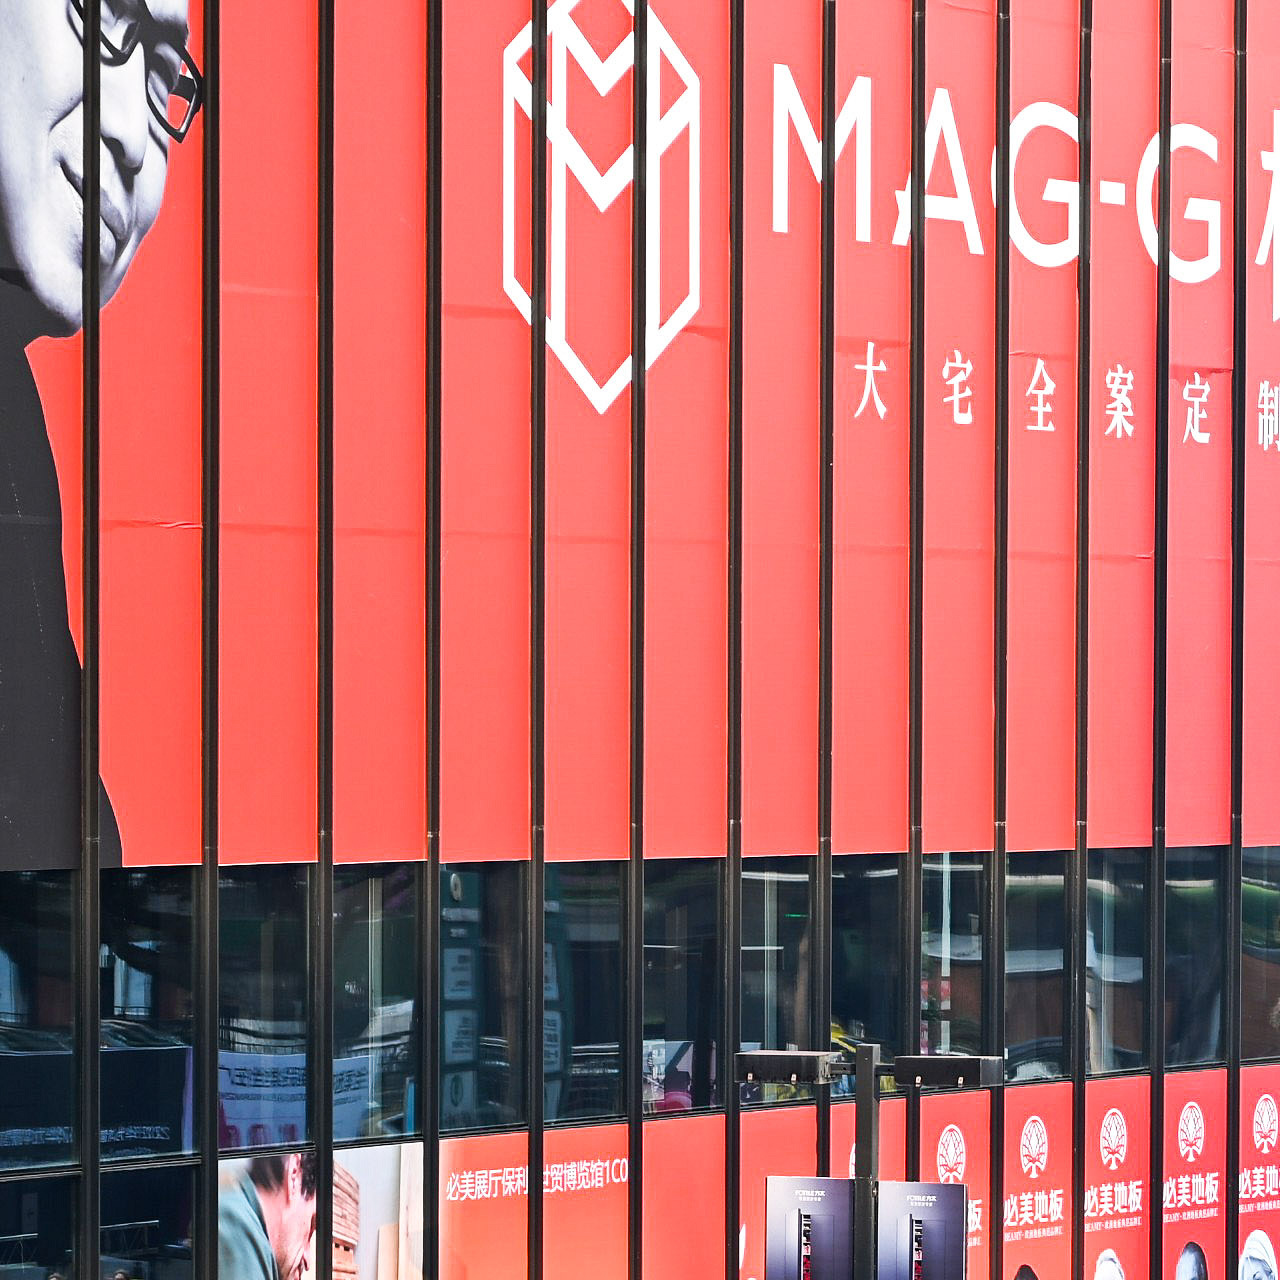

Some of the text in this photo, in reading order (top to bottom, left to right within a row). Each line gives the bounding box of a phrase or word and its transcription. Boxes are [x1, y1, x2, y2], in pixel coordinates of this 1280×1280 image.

[771, 62, 1222, 284] MAG-G
[1004, 1189, 1064, 1228] 必美地板
[1084, 1180, 1143, 1218] 必美地板
[1163, 1172, 1219, 1209] 必美地板
